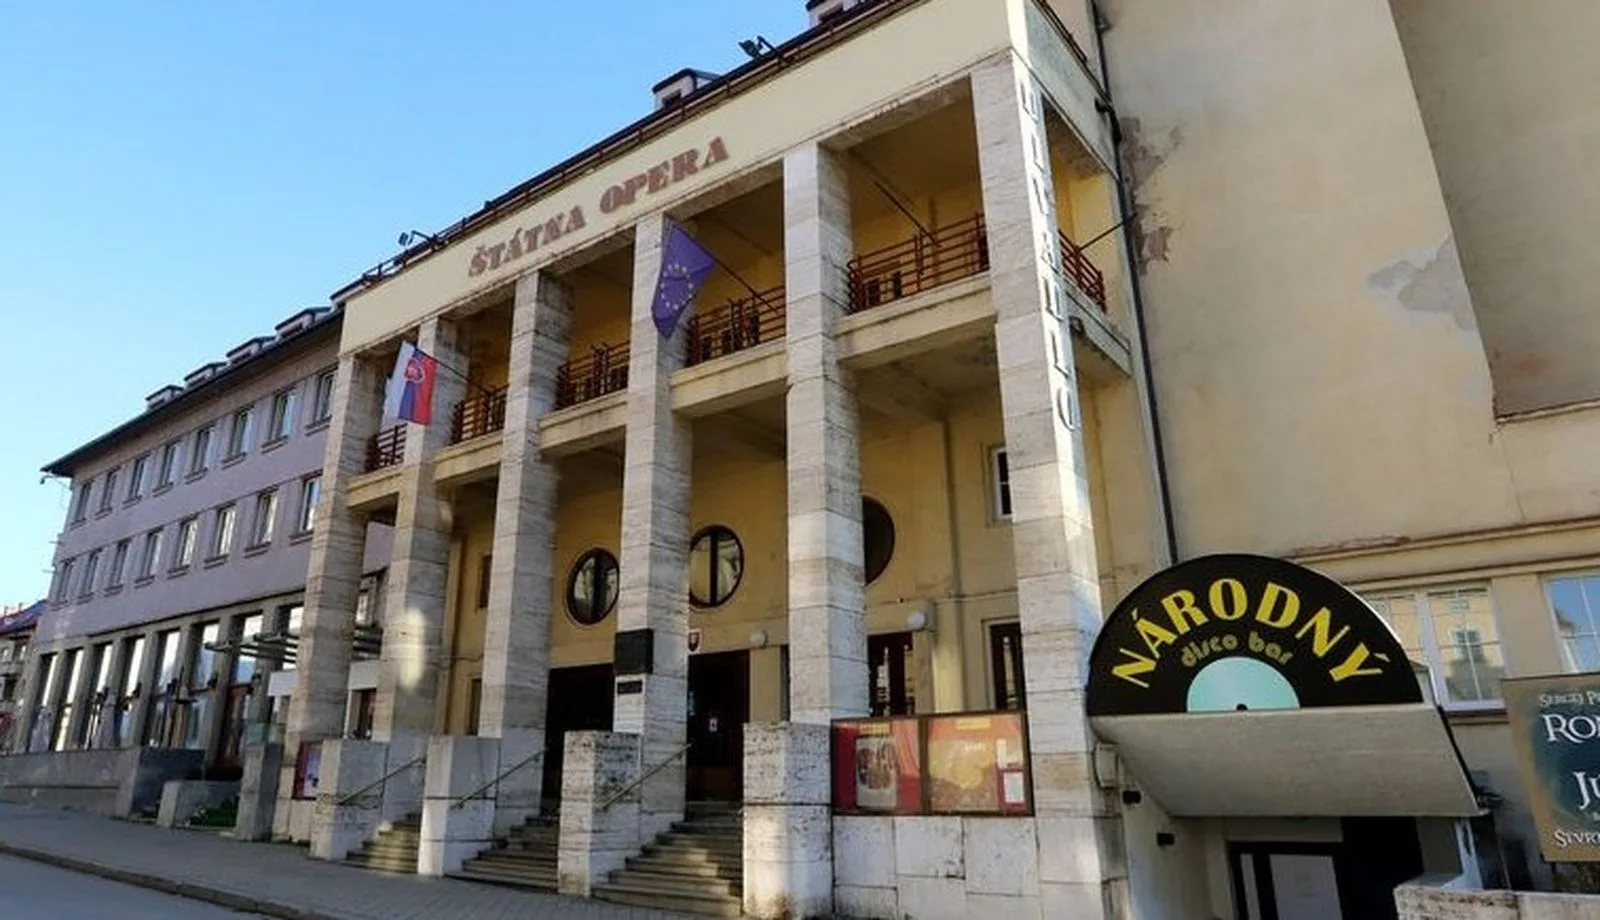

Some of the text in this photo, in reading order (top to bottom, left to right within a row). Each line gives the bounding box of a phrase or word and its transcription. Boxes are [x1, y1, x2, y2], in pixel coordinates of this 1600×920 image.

[600, 136, 729, 214] OPERA
[1111, 578, 1390, 688] NÁRODNÝ
[1181, 631, 1294, 667] disco bar
